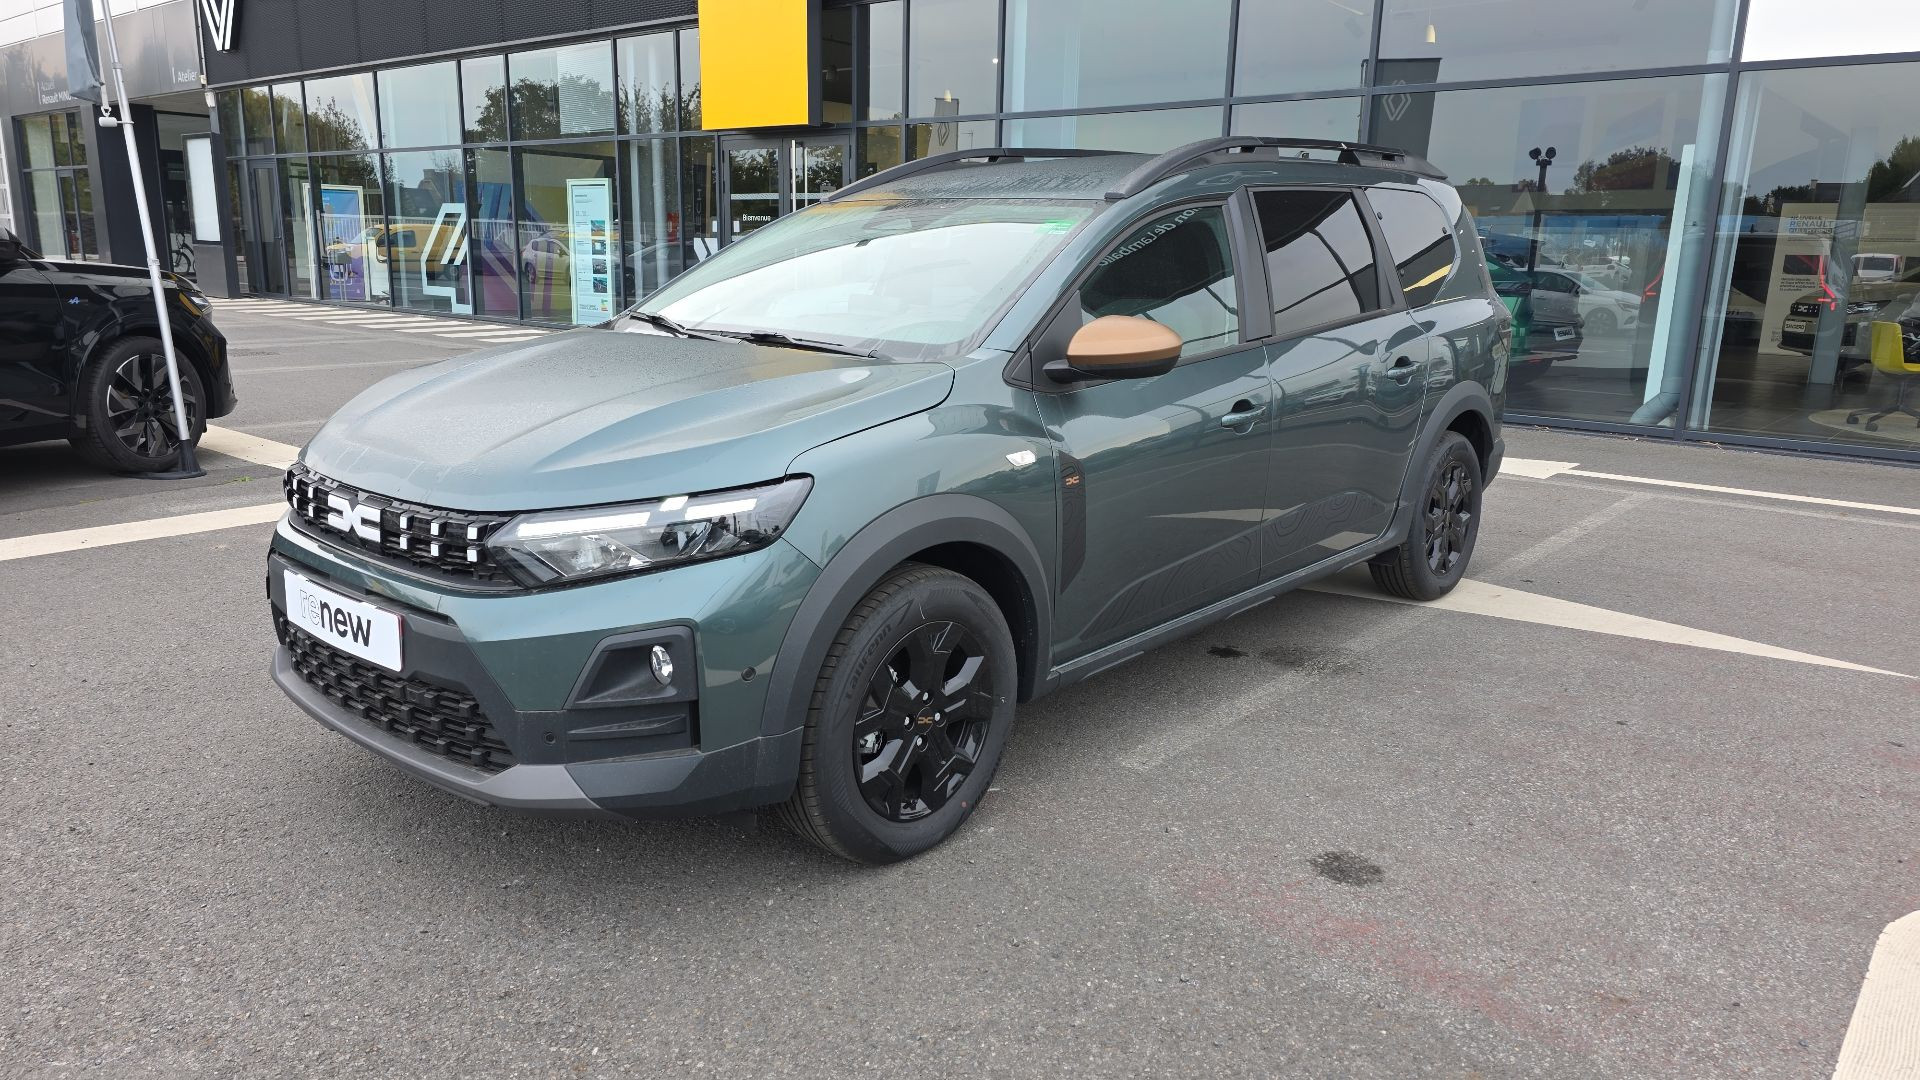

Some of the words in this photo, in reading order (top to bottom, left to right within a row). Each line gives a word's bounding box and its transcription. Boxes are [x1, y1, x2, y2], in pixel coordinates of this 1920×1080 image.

[177, 68, 198, 83] Atelier
[742, 213, 771, 222] Bienvenue
[1789, 220, 1834, 228] RENAULT
[300, 588, 371, 647] renew
